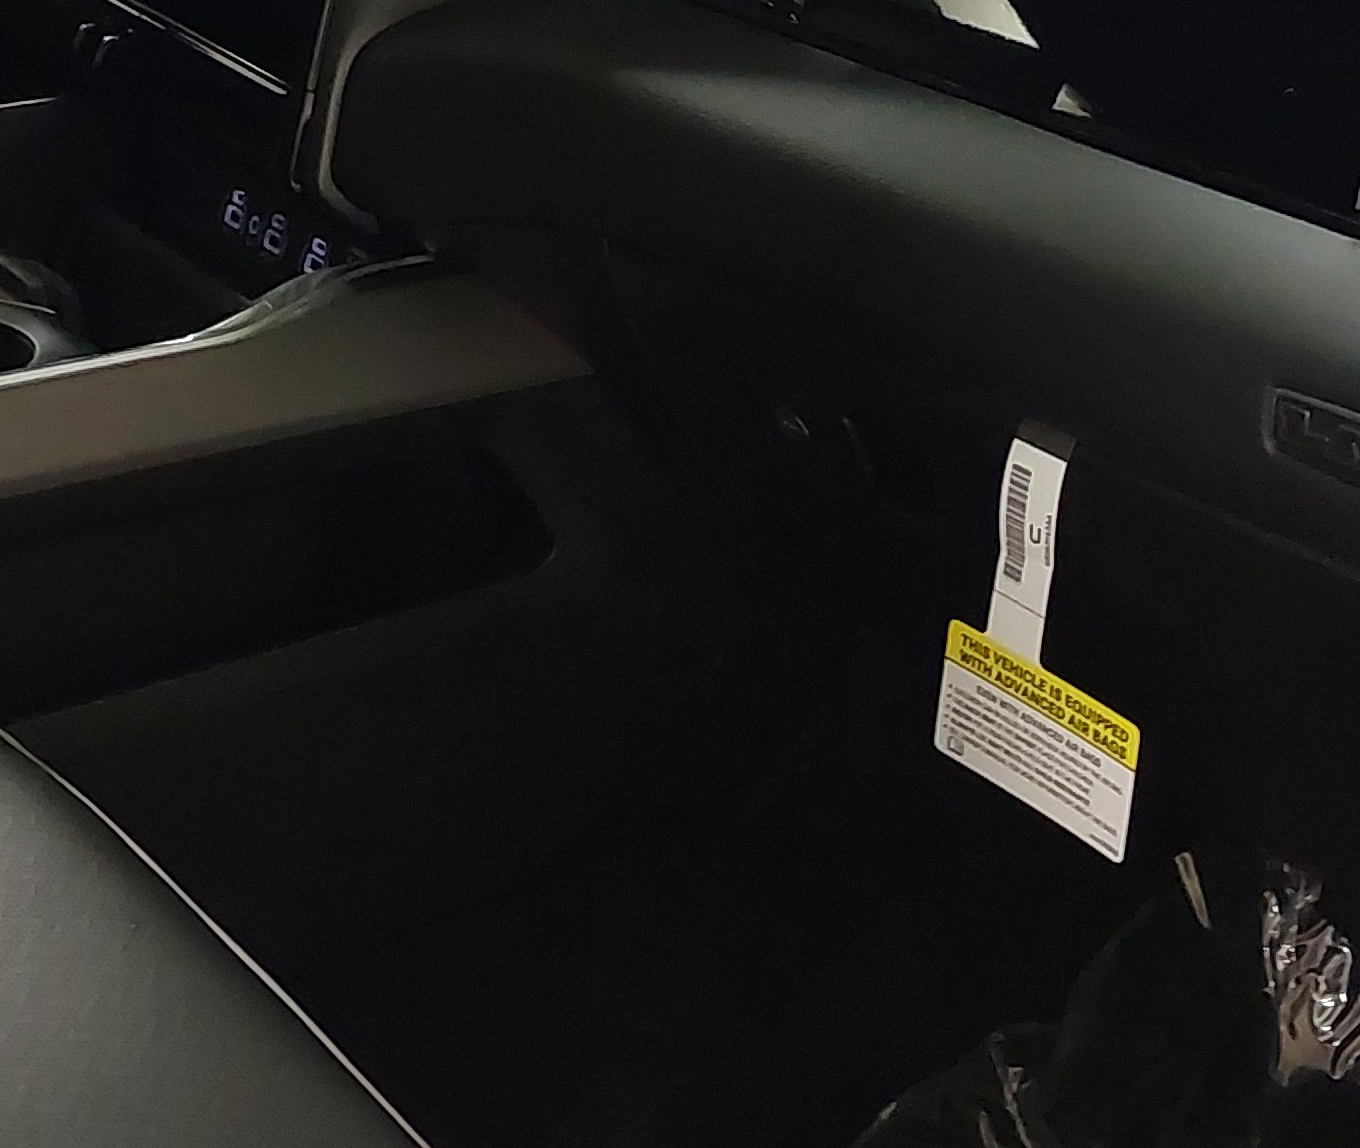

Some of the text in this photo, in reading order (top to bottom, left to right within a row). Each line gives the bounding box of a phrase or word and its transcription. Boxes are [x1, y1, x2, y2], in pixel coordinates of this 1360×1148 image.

[959, 649, 1128, 761] WITH ADVANCED AIR BAGS
[960, 633, 1130, 743] THIS VEHICLE IS EQUIPPED
